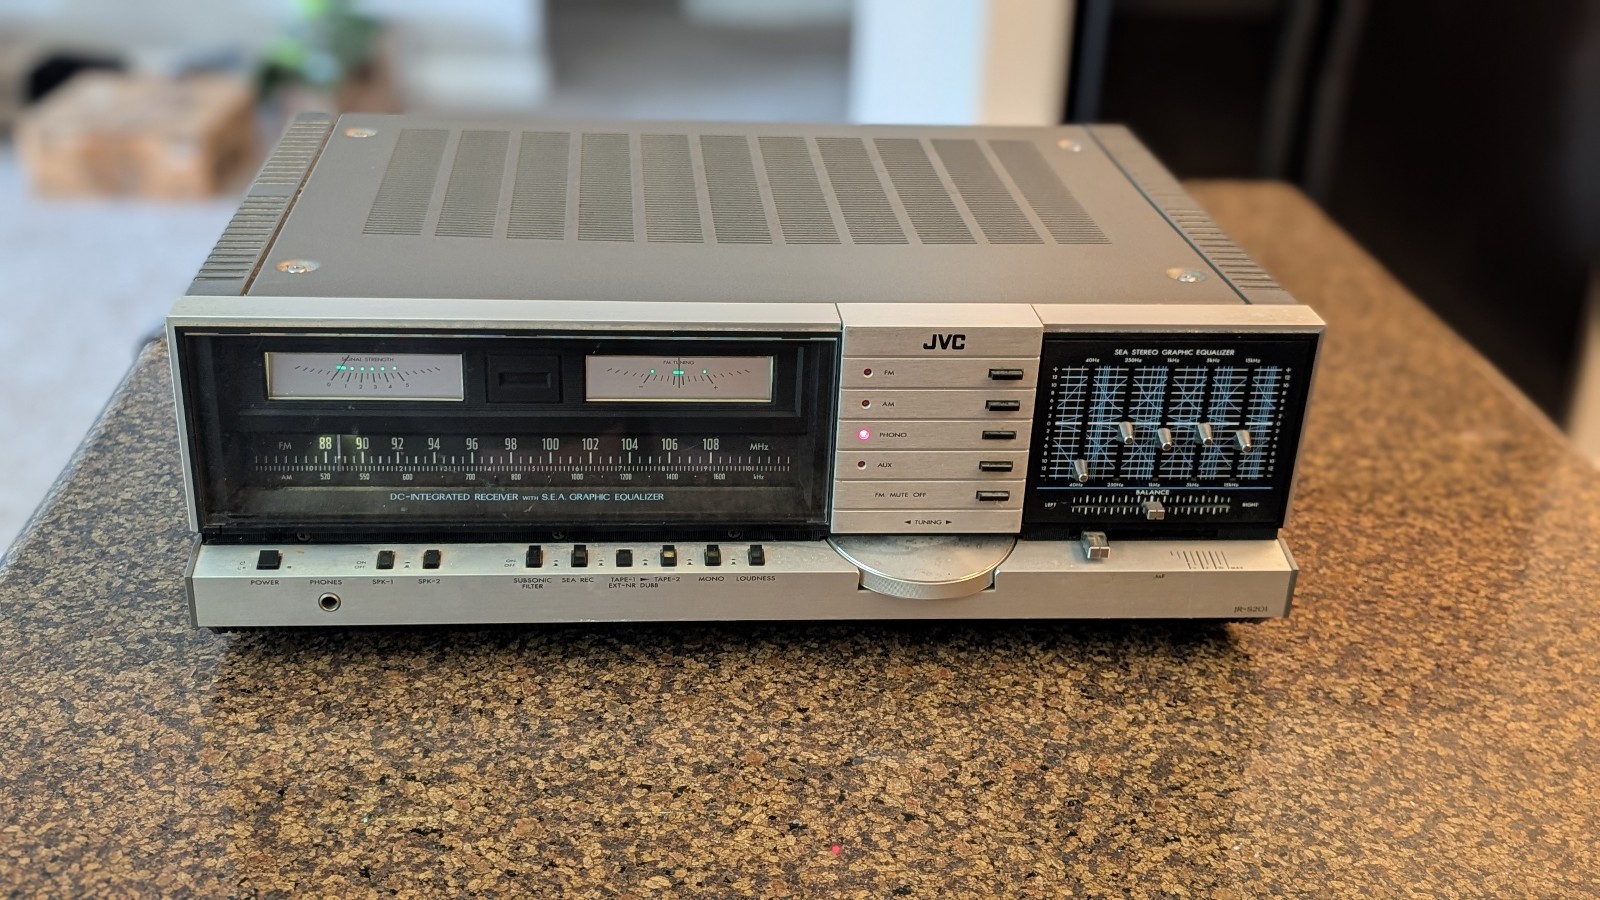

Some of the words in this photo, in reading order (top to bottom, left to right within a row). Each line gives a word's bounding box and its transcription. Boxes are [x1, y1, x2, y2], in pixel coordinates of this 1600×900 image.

[923, 334, 966, 350] JVC
[319, 437, 332, 449] 88
[356, 437, 369, 449] 90
[391, 437, 404, 449] 92
[428, 438, 440, 450] 94
[466, 438, 478, 450] 96
[505, 438, 517, 450] 98
[542, 438, 559, 450] 100
[582, 438, 599, 450] 102
[622, 438, 638, 450] 104
[662, 438, 678, 450] 106
[703, 438, 719, 450] 108
